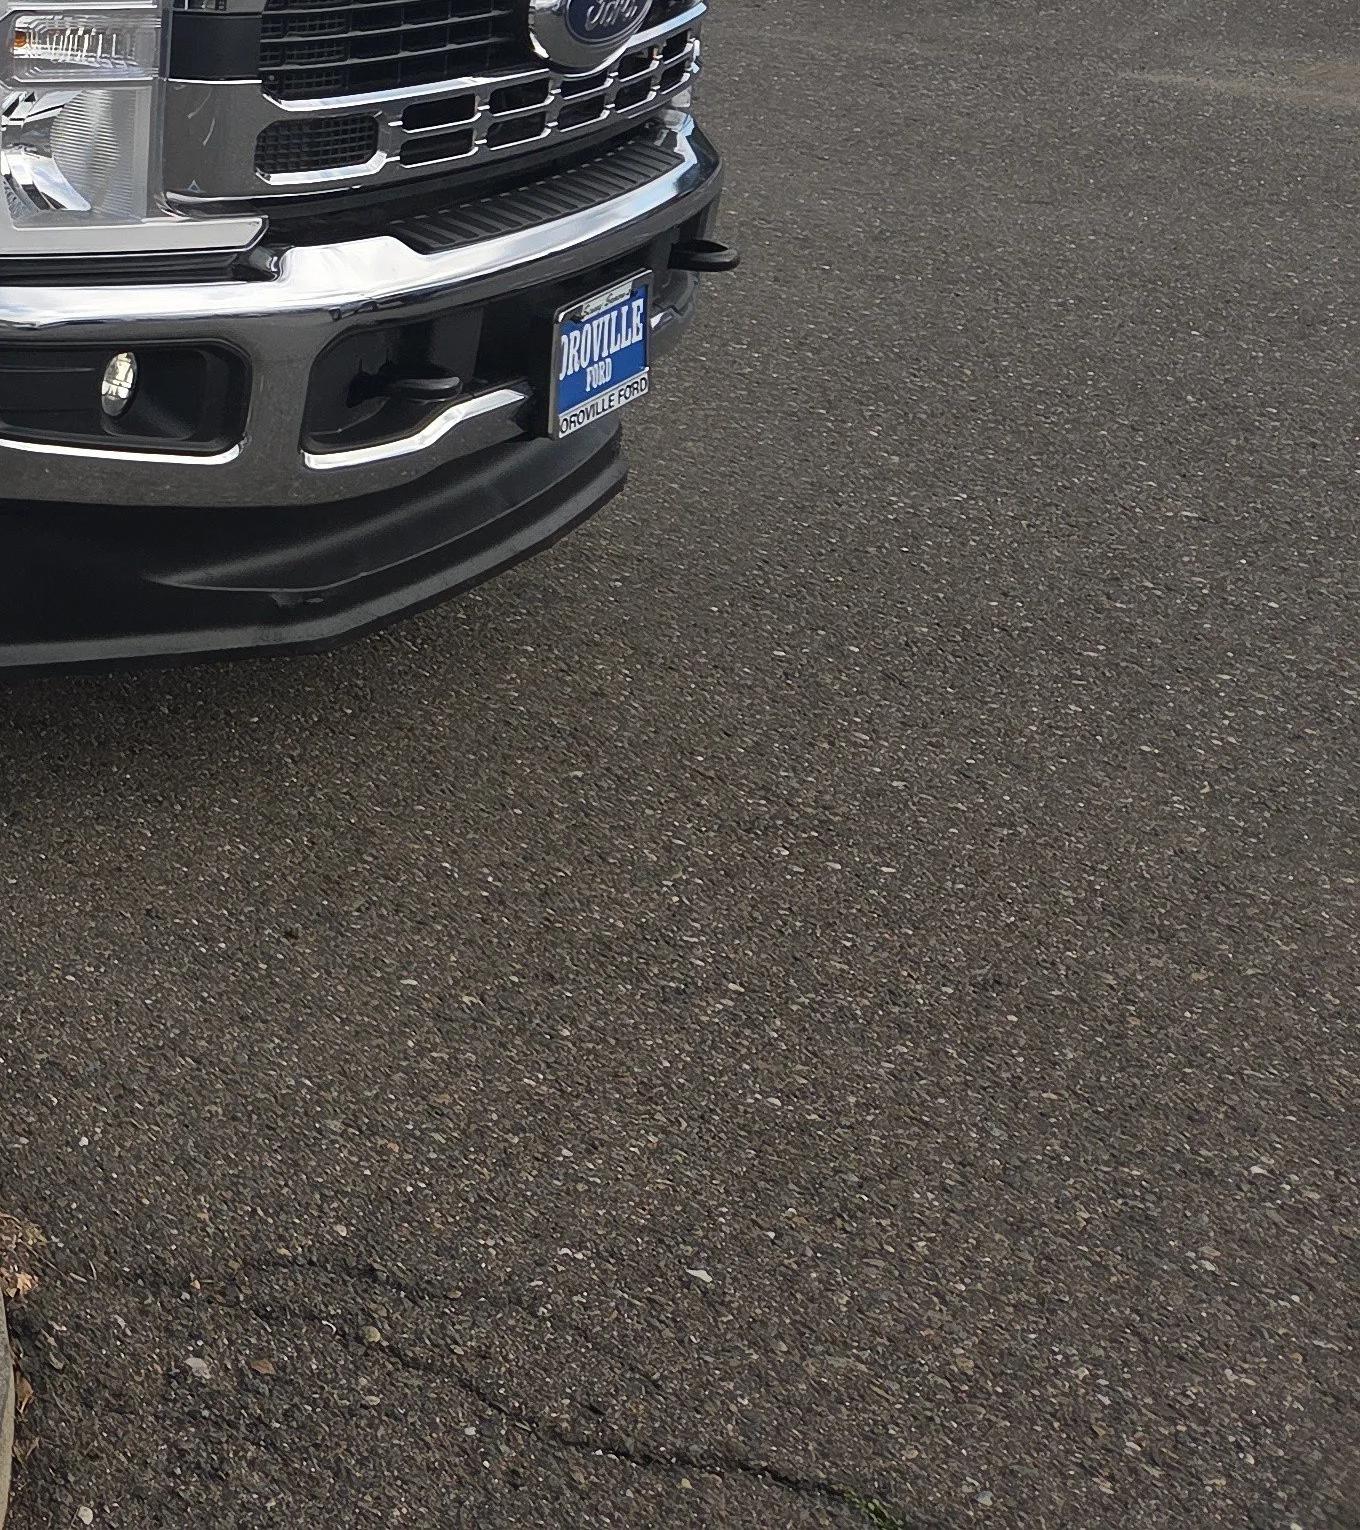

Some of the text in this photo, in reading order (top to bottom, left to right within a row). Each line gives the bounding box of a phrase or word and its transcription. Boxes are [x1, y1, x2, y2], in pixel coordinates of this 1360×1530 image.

[585, 357, 613, 392] FORD
[560, 377, 648, 434] OROVILLE FORD
